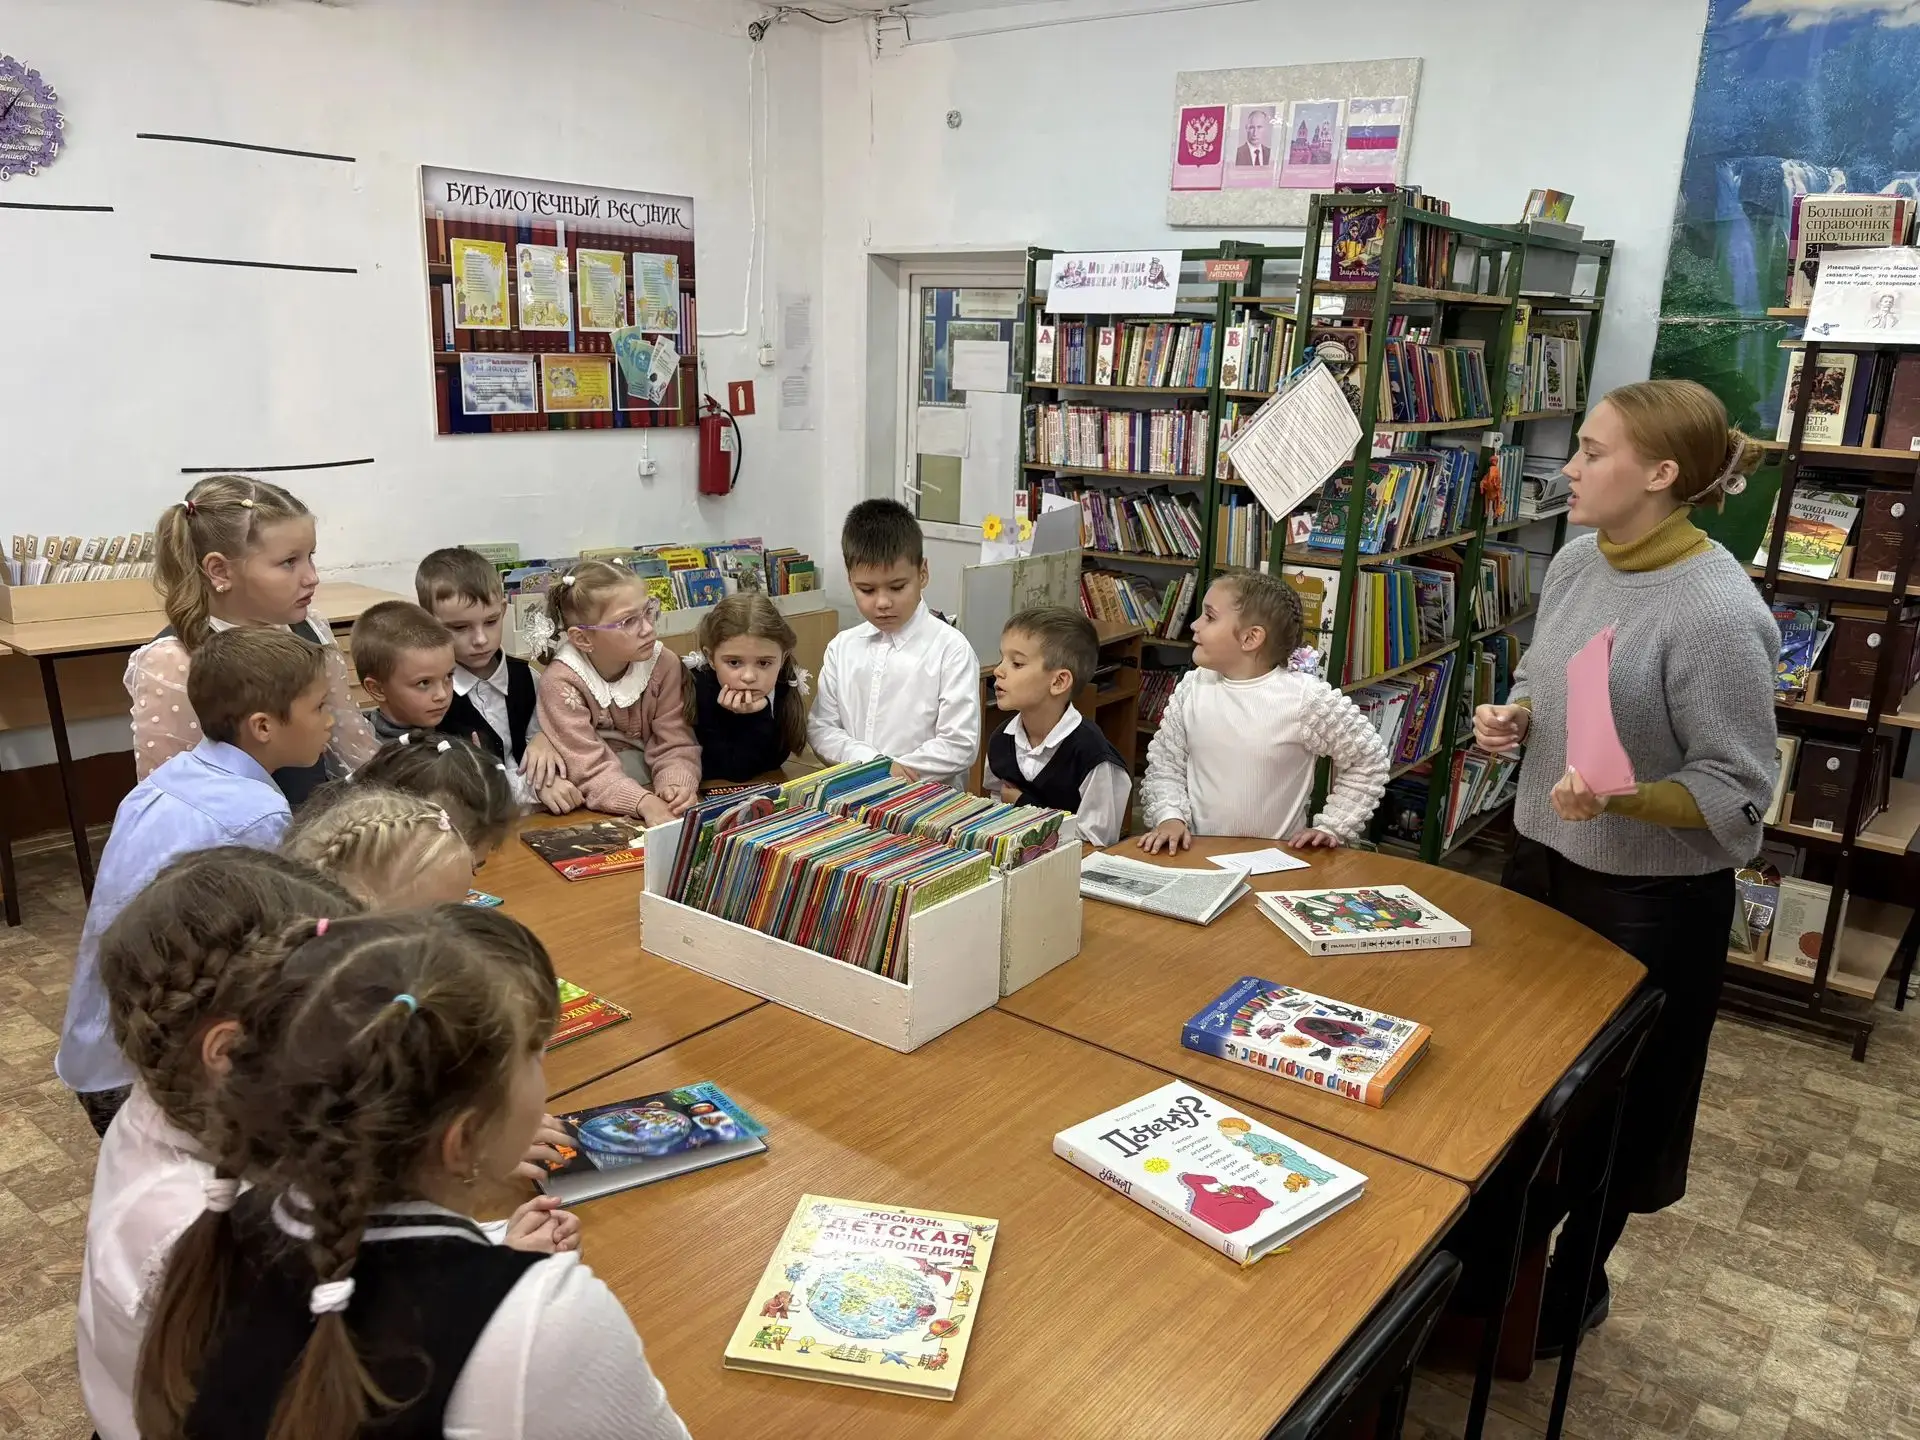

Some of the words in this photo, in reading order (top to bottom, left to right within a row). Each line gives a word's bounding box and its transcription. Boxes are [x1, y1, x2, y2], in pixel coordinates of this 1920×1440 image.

[22, 60, 29, 76] 1
[47, 84, 57, 100] 2
[56, 115, 65, 130] 3
[49, 142, 59, 157] 4
[0, 165, 10, 181] 6
[28, 161, 39, 176] 5
[445, 181, 601, 219] БИБЛИОТЕЧНЫЙ
[606, 199, 691, 230] ВЕСТНИК
[1807, 204, 1873, 218] Большой
[1805, 219, 1891, 232] справочник
[1805, 231, 1885, 242] школьника
[1213, 263, 1240, 272] ДЕТСКАЯ
[1039, 328, 1053, 344] А
[1101, 330, 1113, 346] Б
[1227, 331, 1240, 347] В
[1373, 433, 1393, 449] Ж
[1794, 502, 1850, 520] ОЖИДАНИИ
[1802, 512, 1826, 524] ЧУДА
[15, 542, 20, 552] 2
[27, 540, 33, 551] 2
[49, 545, 55, 555] 3
[64, 543, 70, 553] 4
[604, 850, 635, 862] МИР
[559, 1001, 603, 1023] МЛЕКО
[1240, 1047, 1269, 1070] нас
[1269, 1056, 1325, 1087] вокруг
[1326, 1073, 1362, 1100] Мир
[1098, 1095, 1213, 1159] Почему?
[826, 1217, 971, 1247] ДЕТСКАЯ
[822, 1231, 966, 1259] ЭНЦИКЛОПЕДИЯ
